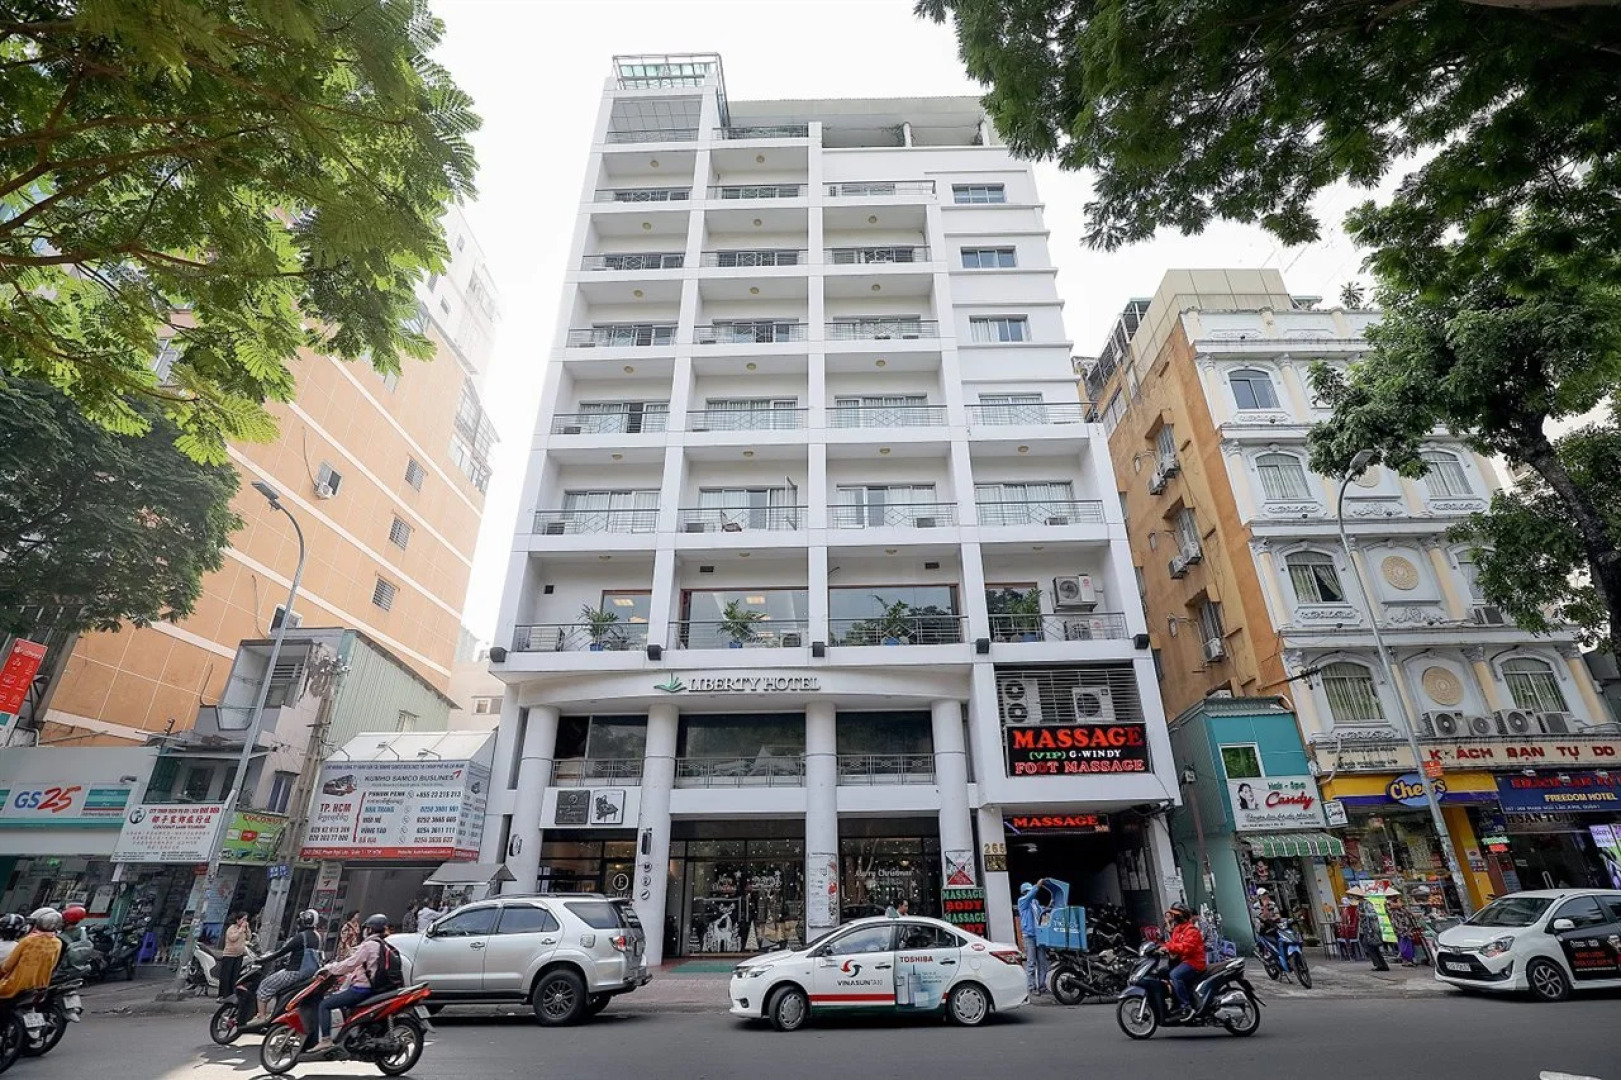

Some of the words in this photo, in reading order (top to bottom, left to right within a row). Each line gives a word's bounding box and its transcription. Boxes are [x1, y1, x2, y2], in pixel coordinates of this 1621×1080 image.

[688, 678, 761, 693] LIBERTY
[763, 677, 821, 692] HOTEL
[1012, 727, 1145, 749] MASSAGE
[1029, 751, 1066, 760] (VIP)
[1430, 745, 1493, 760] KÁCH
[1592, 746, 1615, 757] DO
[1014, 761, 1059, 774] FOOT
[1064, 759, 1146, 773] MASSAGE
[1390, 780, 1446, 799] Chers
[1545, 794, 1590, 802] FREEDOM
[1590, 792, 1618, 801] HOTEL
[14, 786, 82, 813] GS25
[1265, 791, 1315, 810] Candy
[333, 803, 352, 812] HCM
[1013, 815, 1099, 827] MASSAGE
[942, 889, 985, 899] MASSAGE
[945, 913, 986, 923] MASSAGE
